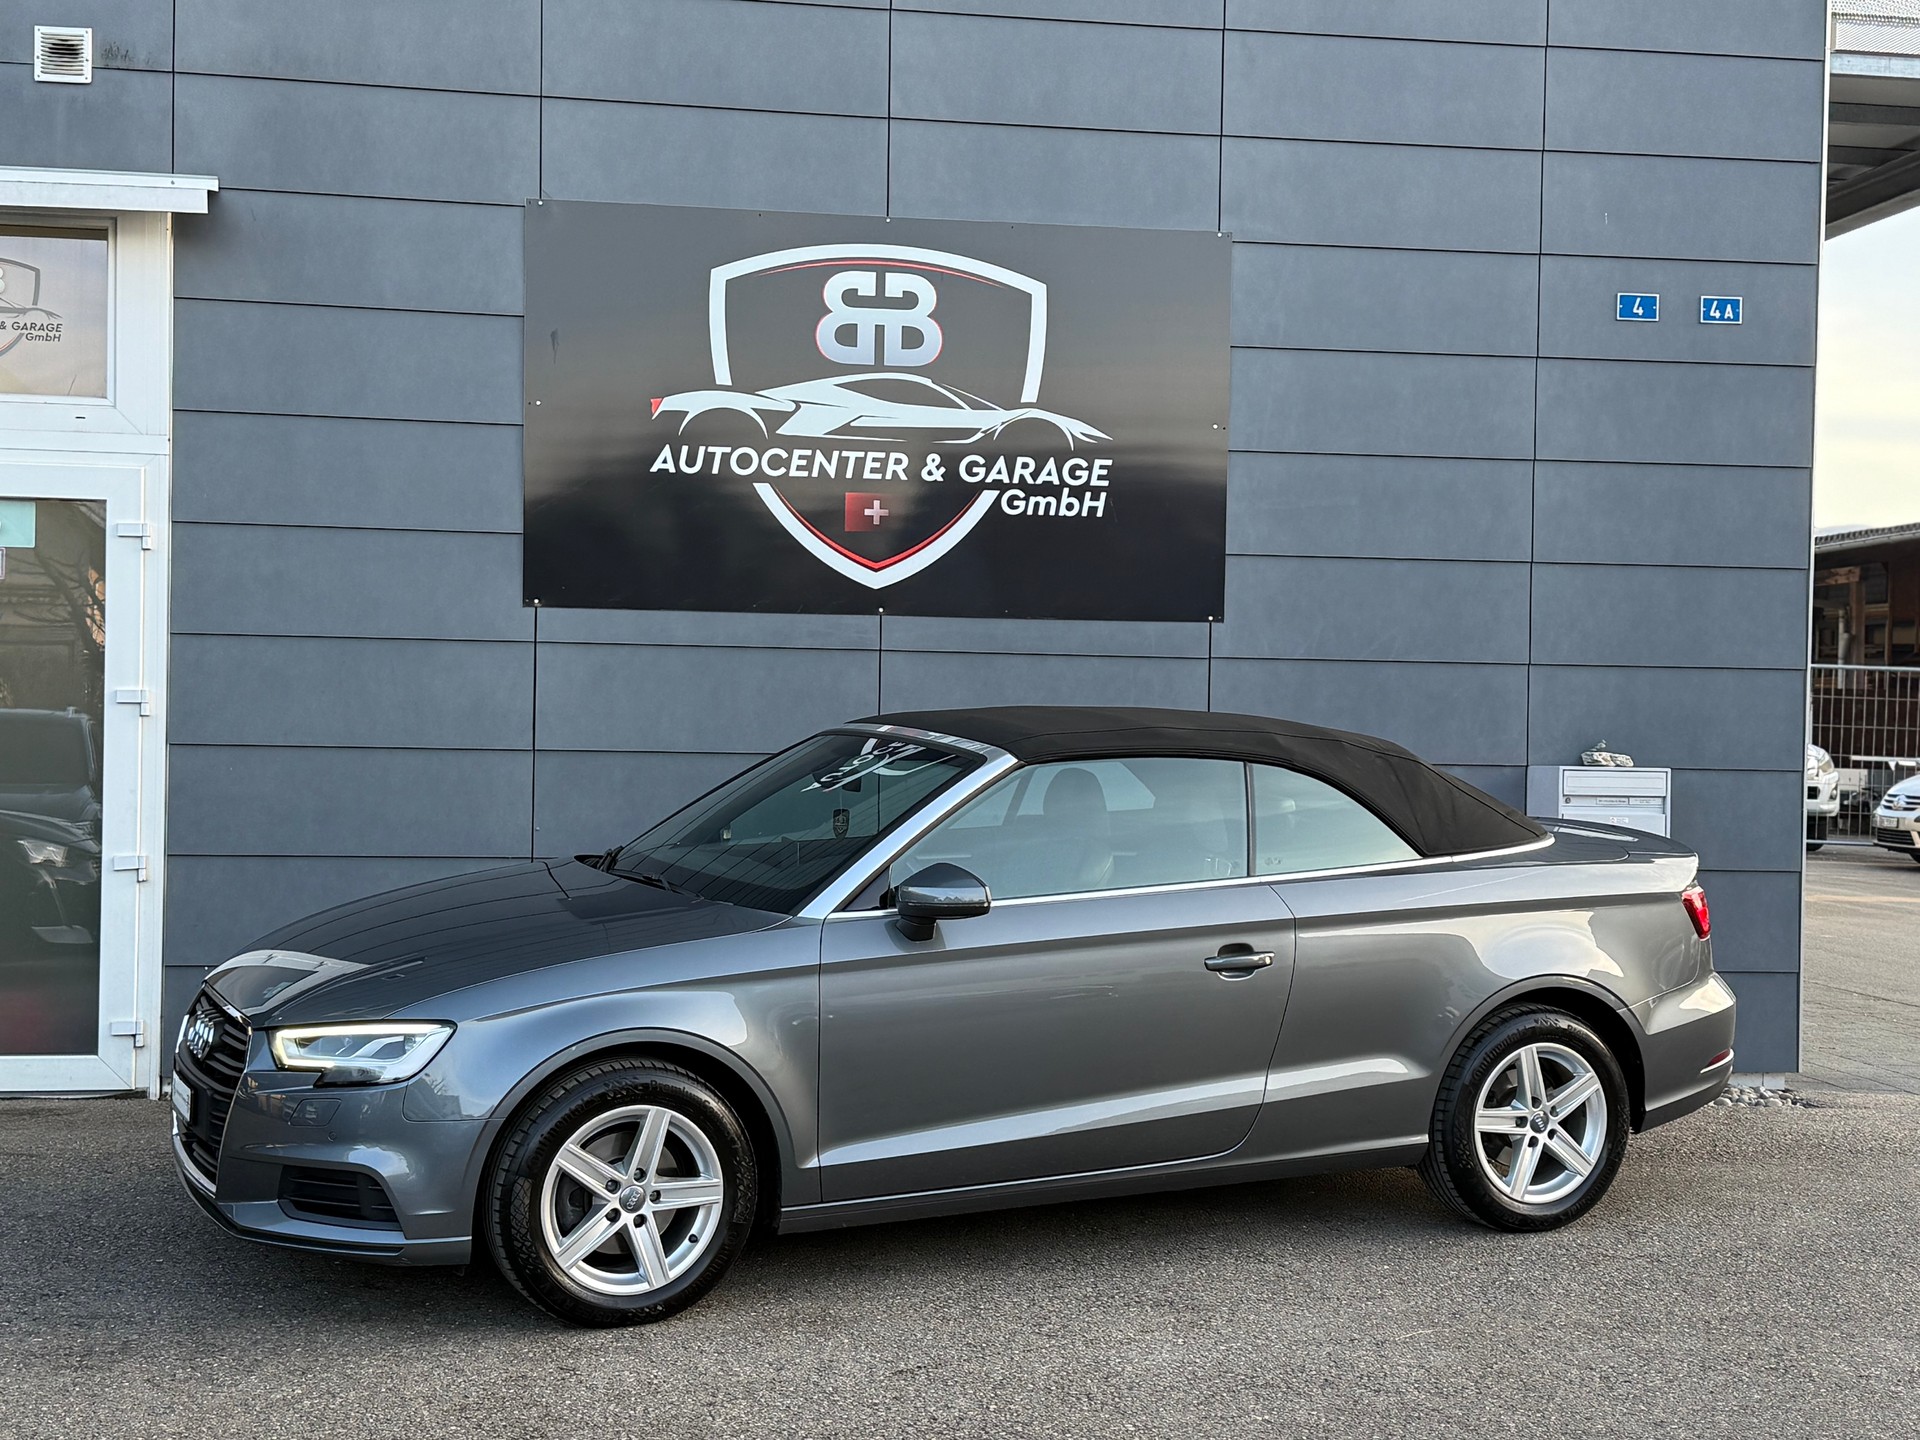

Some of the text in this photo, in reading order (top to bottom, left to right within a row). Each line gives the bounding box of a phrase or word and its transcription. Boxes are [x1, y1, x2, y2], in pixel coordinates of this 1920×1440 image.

[1632, 297, 1644, 316] 4
[1709, 300, 1734, 320] 4A
[11, 321, 63, 333] GARAGE
[25, 332, 62, 342] GmbH
[649, 443, 1113, 487] AUTOCENTER & GARAGE
[1000, 487, 1107, 518] GmbH
[526, 1096, 587, 1171] Continental
